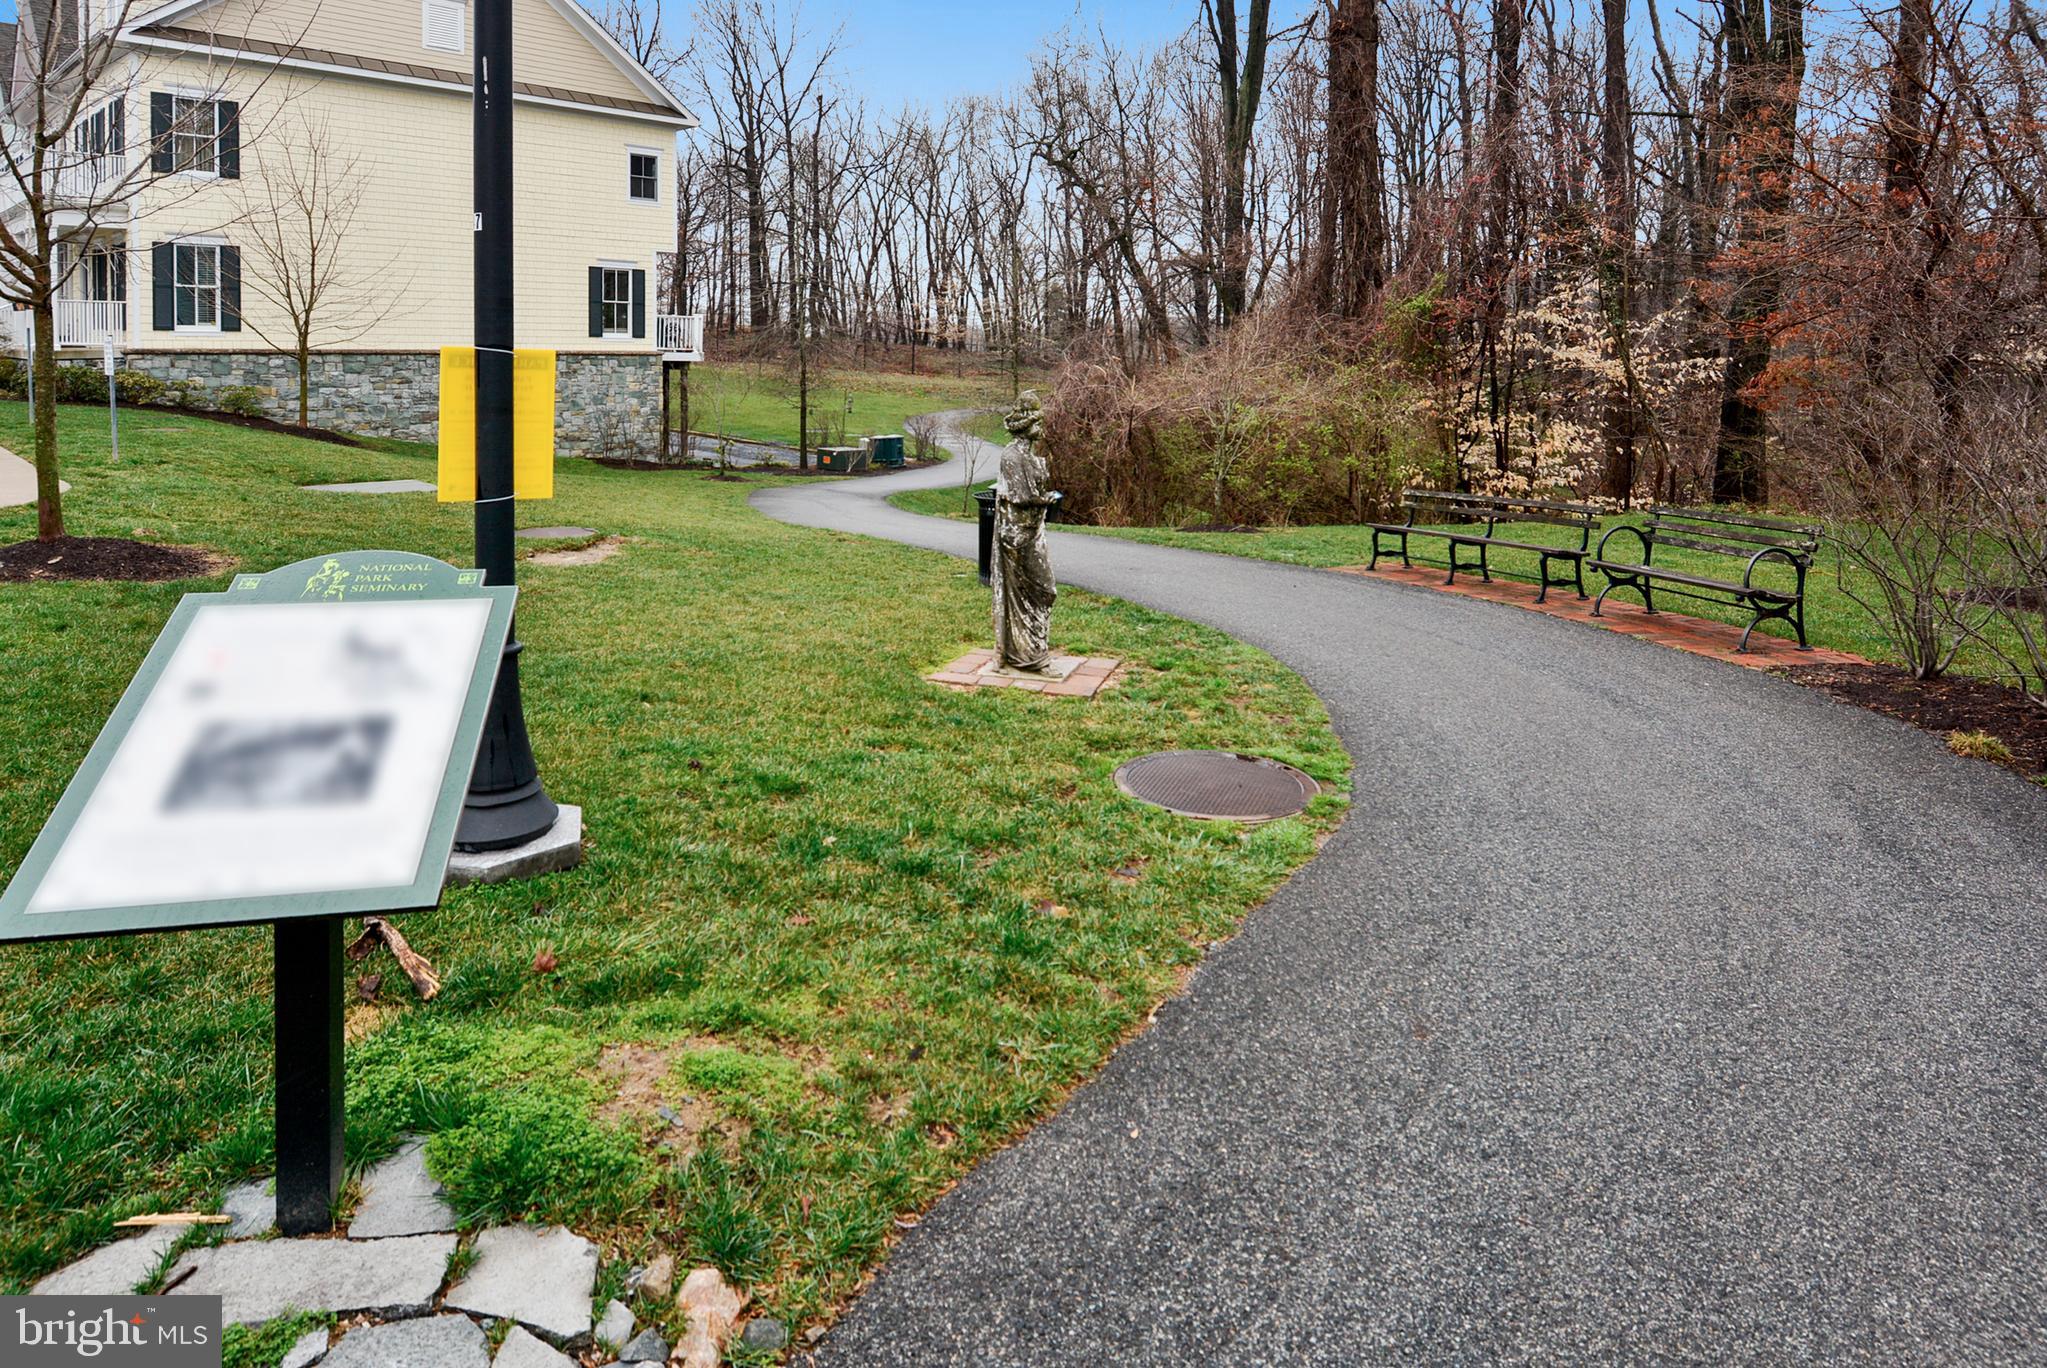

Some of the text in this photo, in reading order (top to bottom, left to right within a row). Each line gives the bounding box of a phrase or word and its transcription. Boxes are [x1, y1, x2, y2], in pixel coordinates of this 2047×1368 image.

[359, 563, 432, 572] NATIONAL
[355, 574, 392, 582] PARK
[350, 583, 428, 592] SEMINARY
